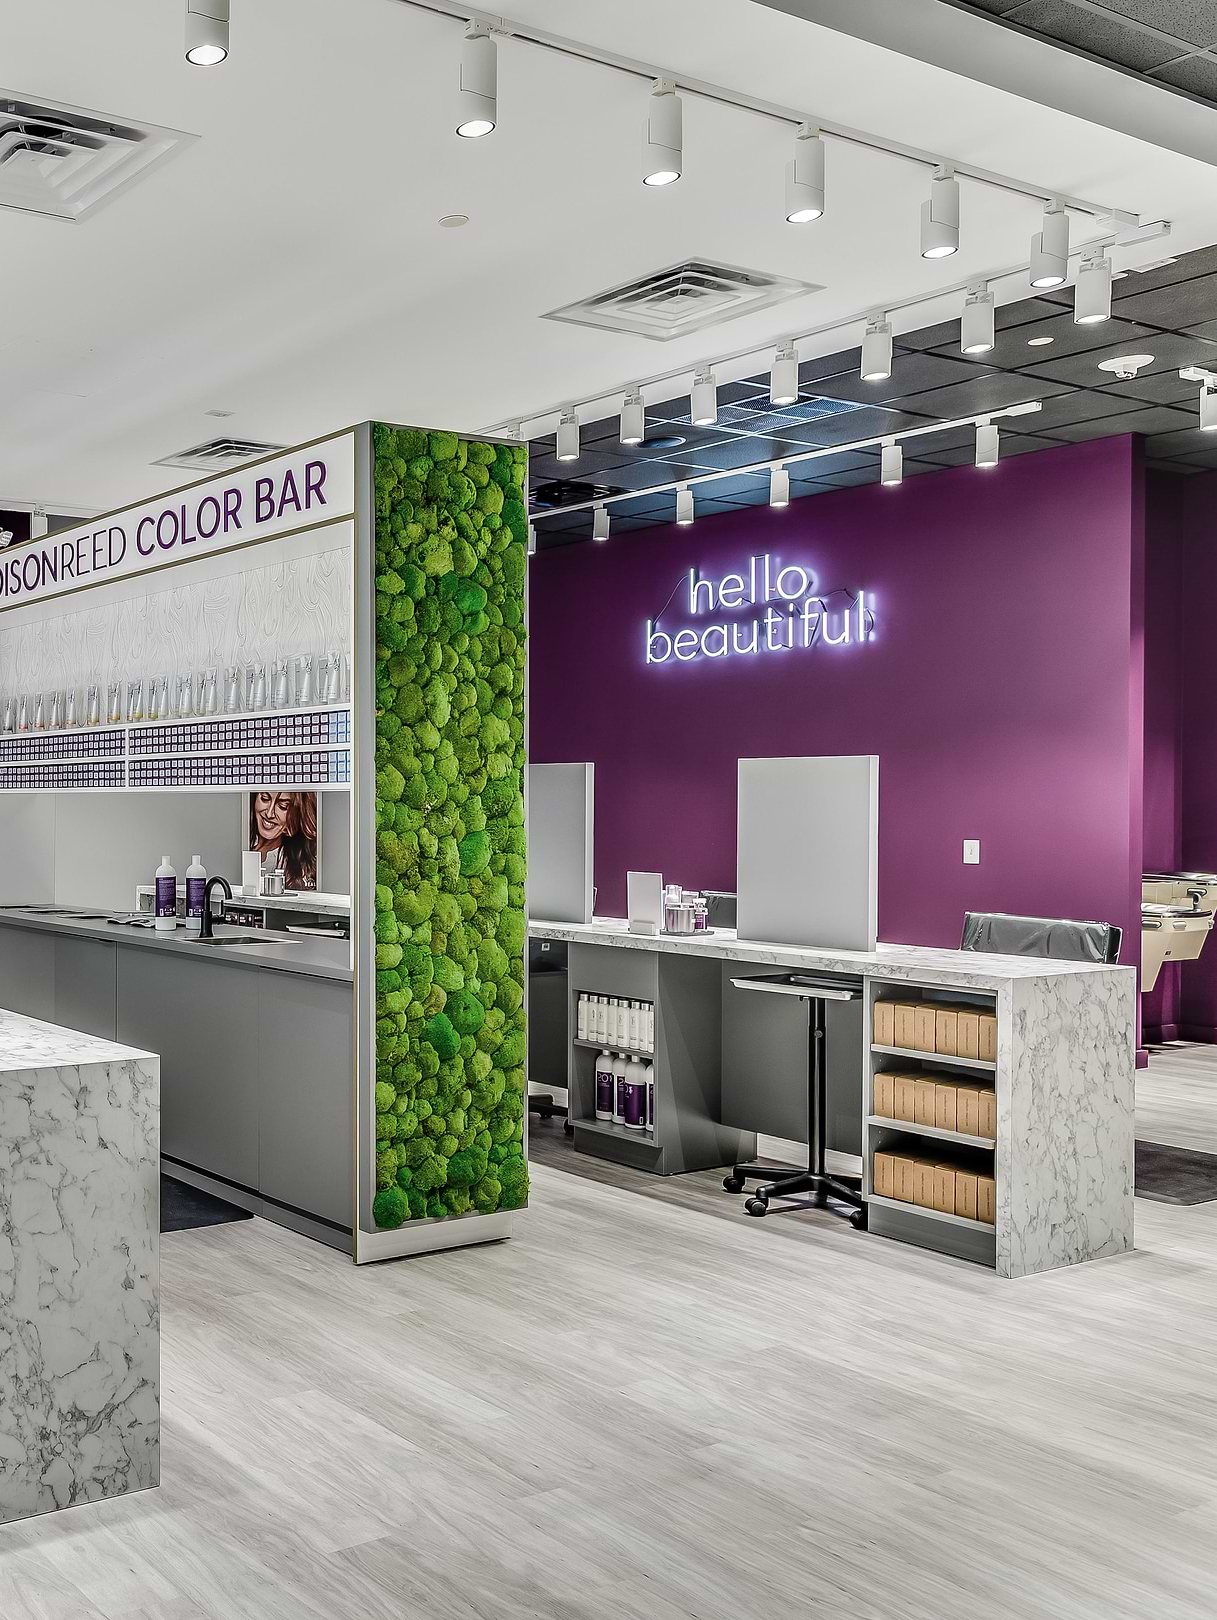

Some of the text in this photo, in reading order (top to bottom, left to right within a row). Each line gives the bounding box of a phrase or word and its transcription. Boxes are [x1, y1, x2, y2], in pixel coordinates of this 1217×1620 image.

[136, 488, 242, 556] COLOR
[255, 460, 327, 524] BAR
[690, 553, 808, 614] hello
[646, 590, 865, 664] beautiful
